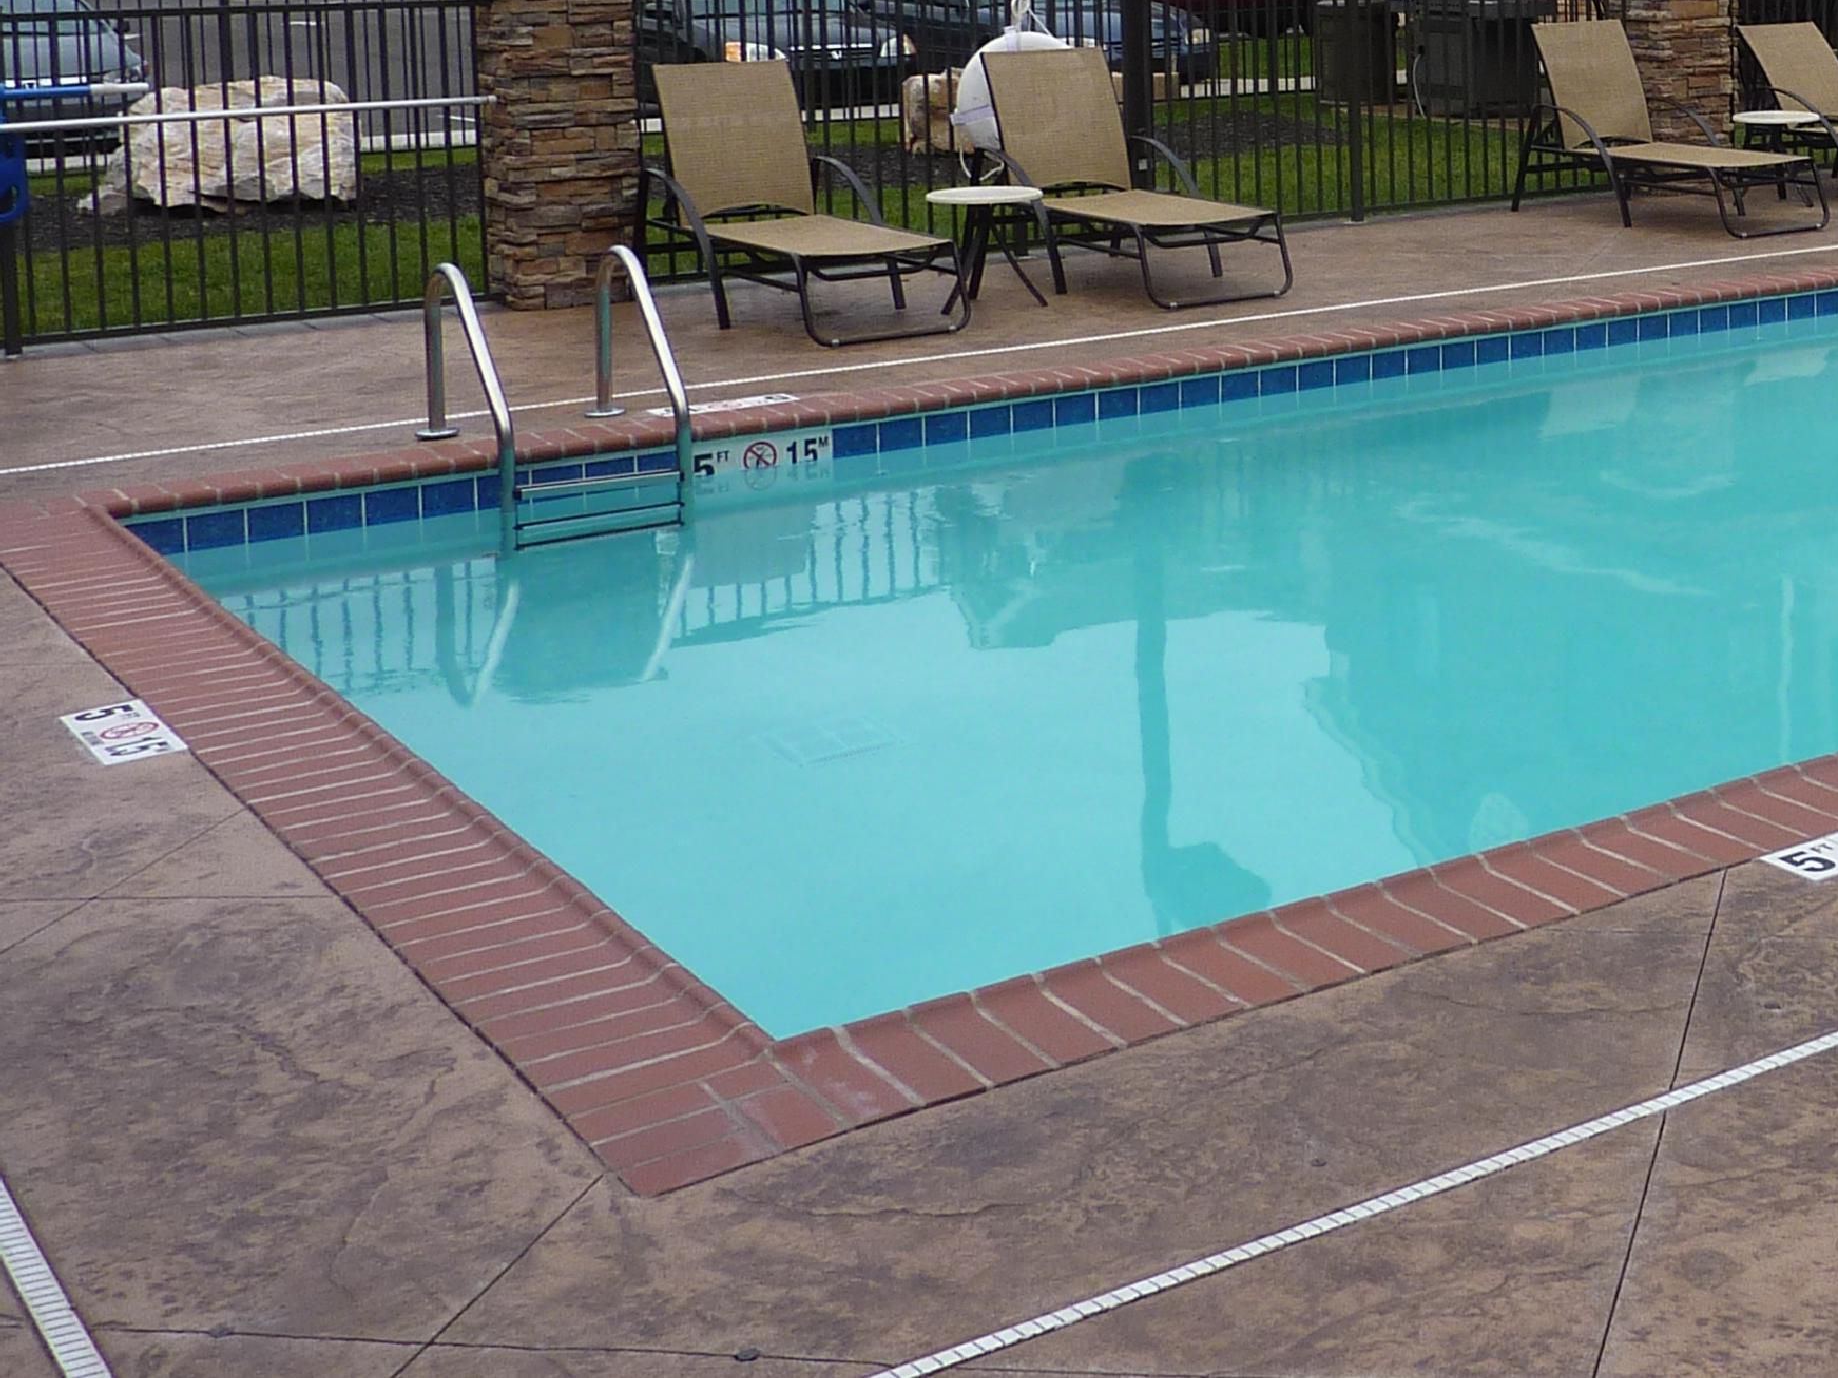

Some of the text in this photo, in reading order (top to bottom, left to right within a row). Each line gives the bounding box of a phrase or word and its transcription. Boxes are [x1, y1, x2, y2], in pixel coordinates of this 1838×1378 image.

[694, 454, 715, 475] 5
[75, 705, 133, 721] 5
[1778, 851, 1836, 872] 5
